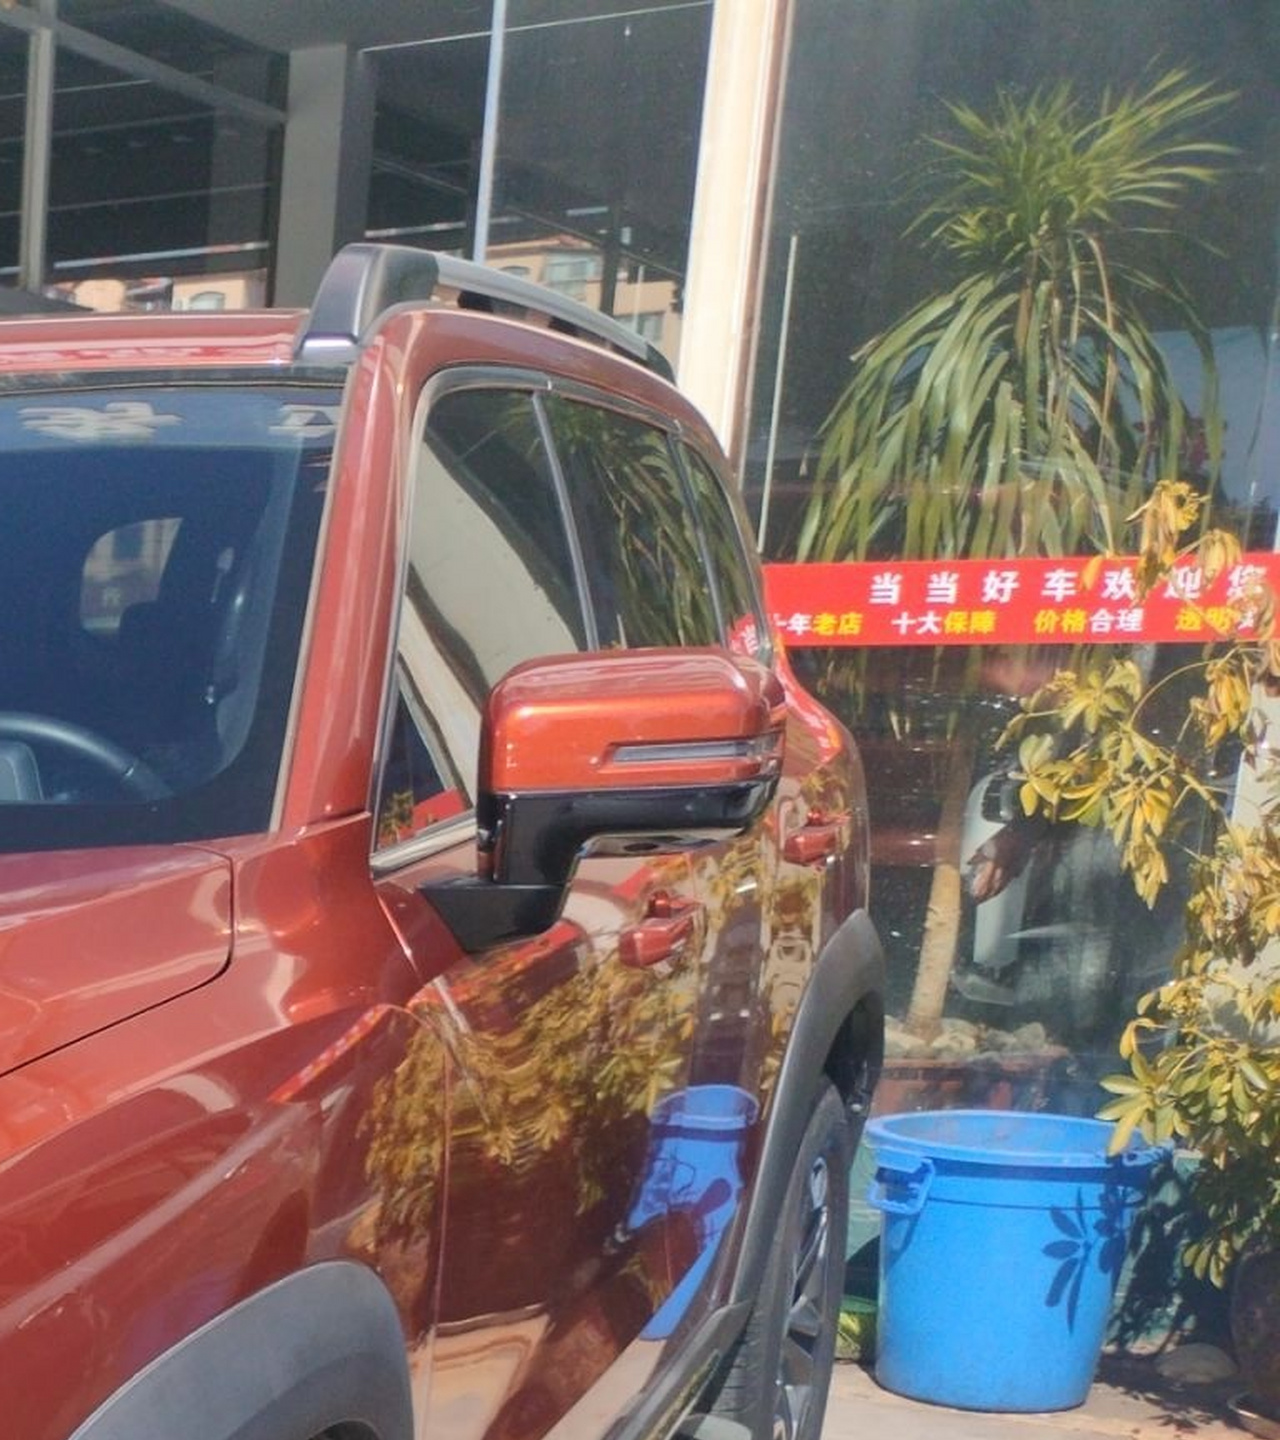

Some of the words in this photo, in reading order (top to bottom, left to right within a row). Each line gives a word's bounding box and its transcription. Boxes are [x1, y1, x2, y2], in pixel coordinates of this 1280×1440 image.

[891, 610, 995, 636] 十大保障
[1034, 607, 1144, 635] 价格合理
